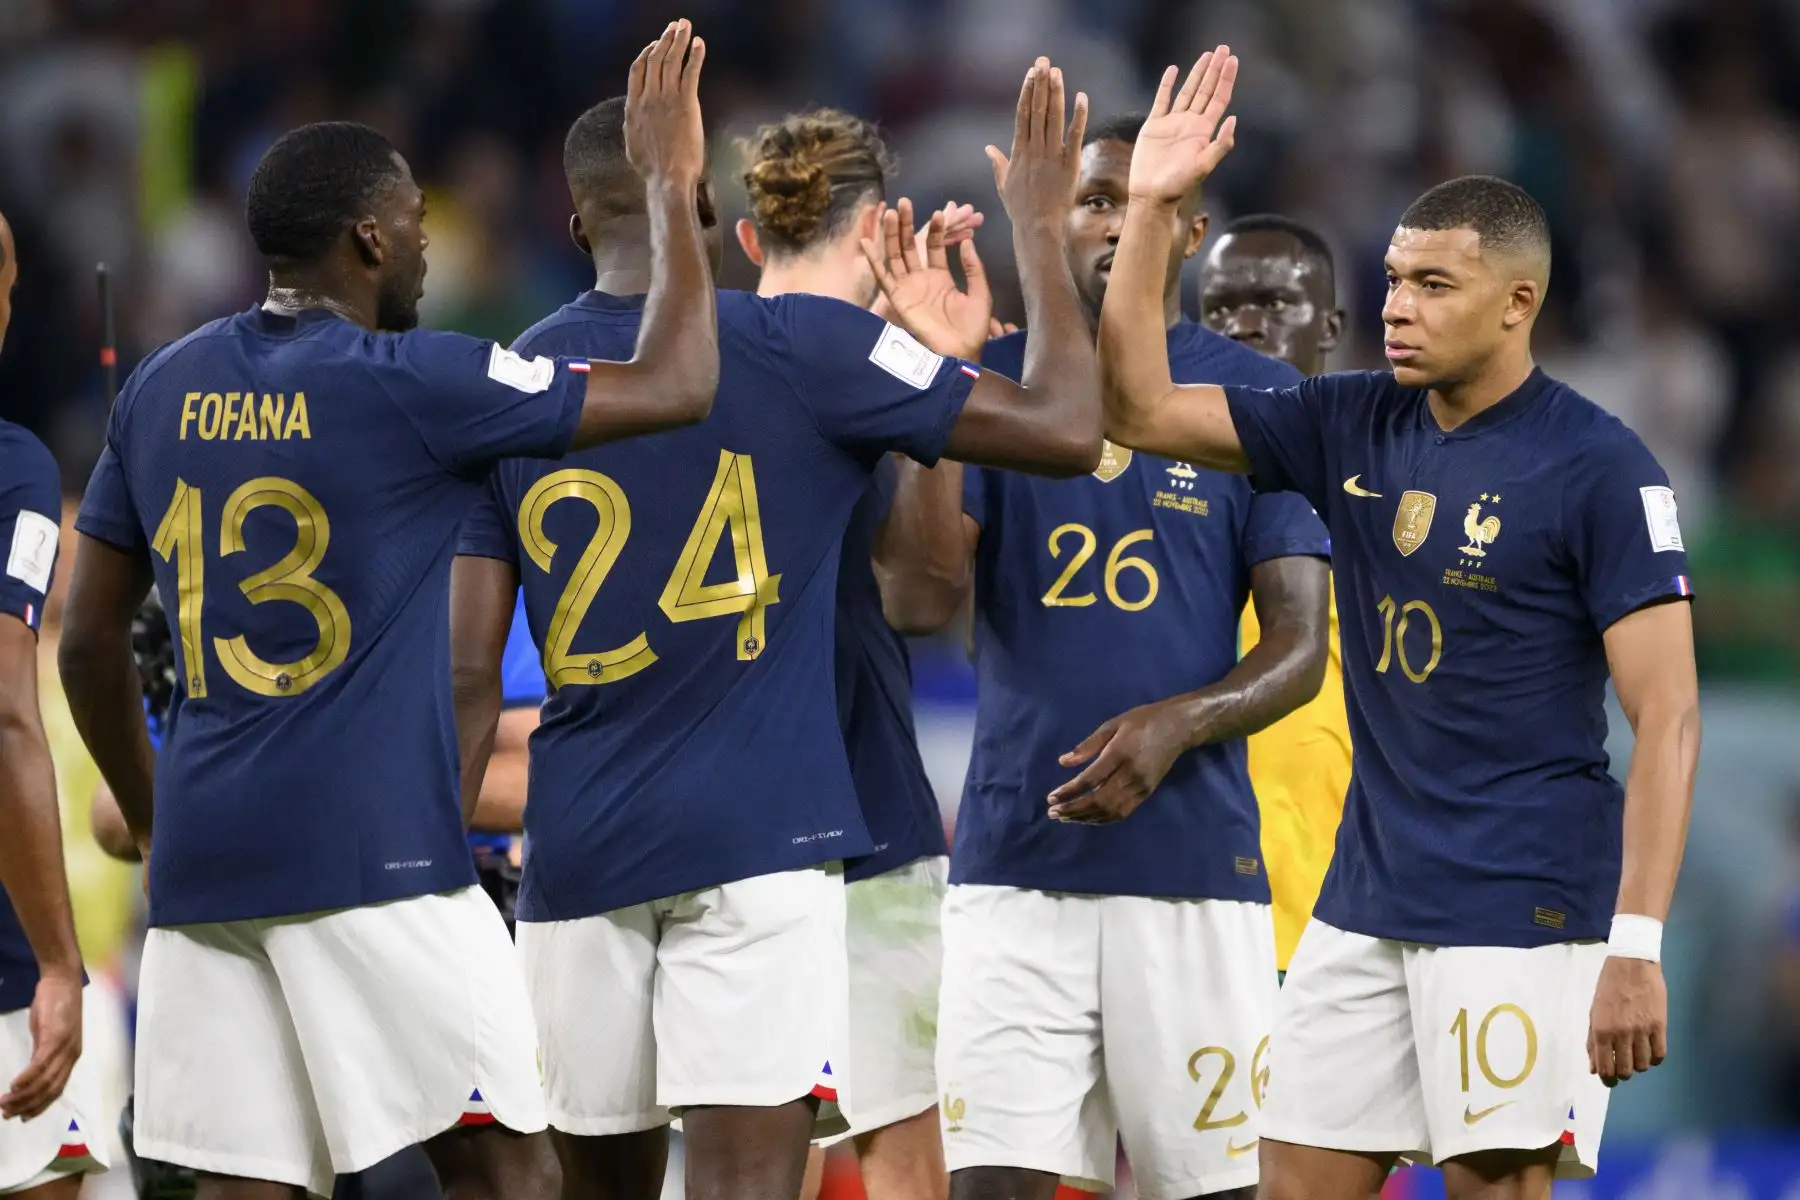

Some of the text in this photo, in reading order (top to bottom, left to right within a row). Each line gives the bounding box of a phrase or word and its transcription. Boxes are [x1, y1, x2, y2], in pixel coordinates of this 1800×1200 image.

[180, 392, 311, 440] FOFANA
[518, 449, 781, 690] 24
[1042, 523, 1158, 611] 26
[1402, 531, 1416, 539] FIFA
[152, 477, 351, 698] 13
[1377, 596, 1442, 682] 10
[1449, 1002, 1539, 1093] 10
